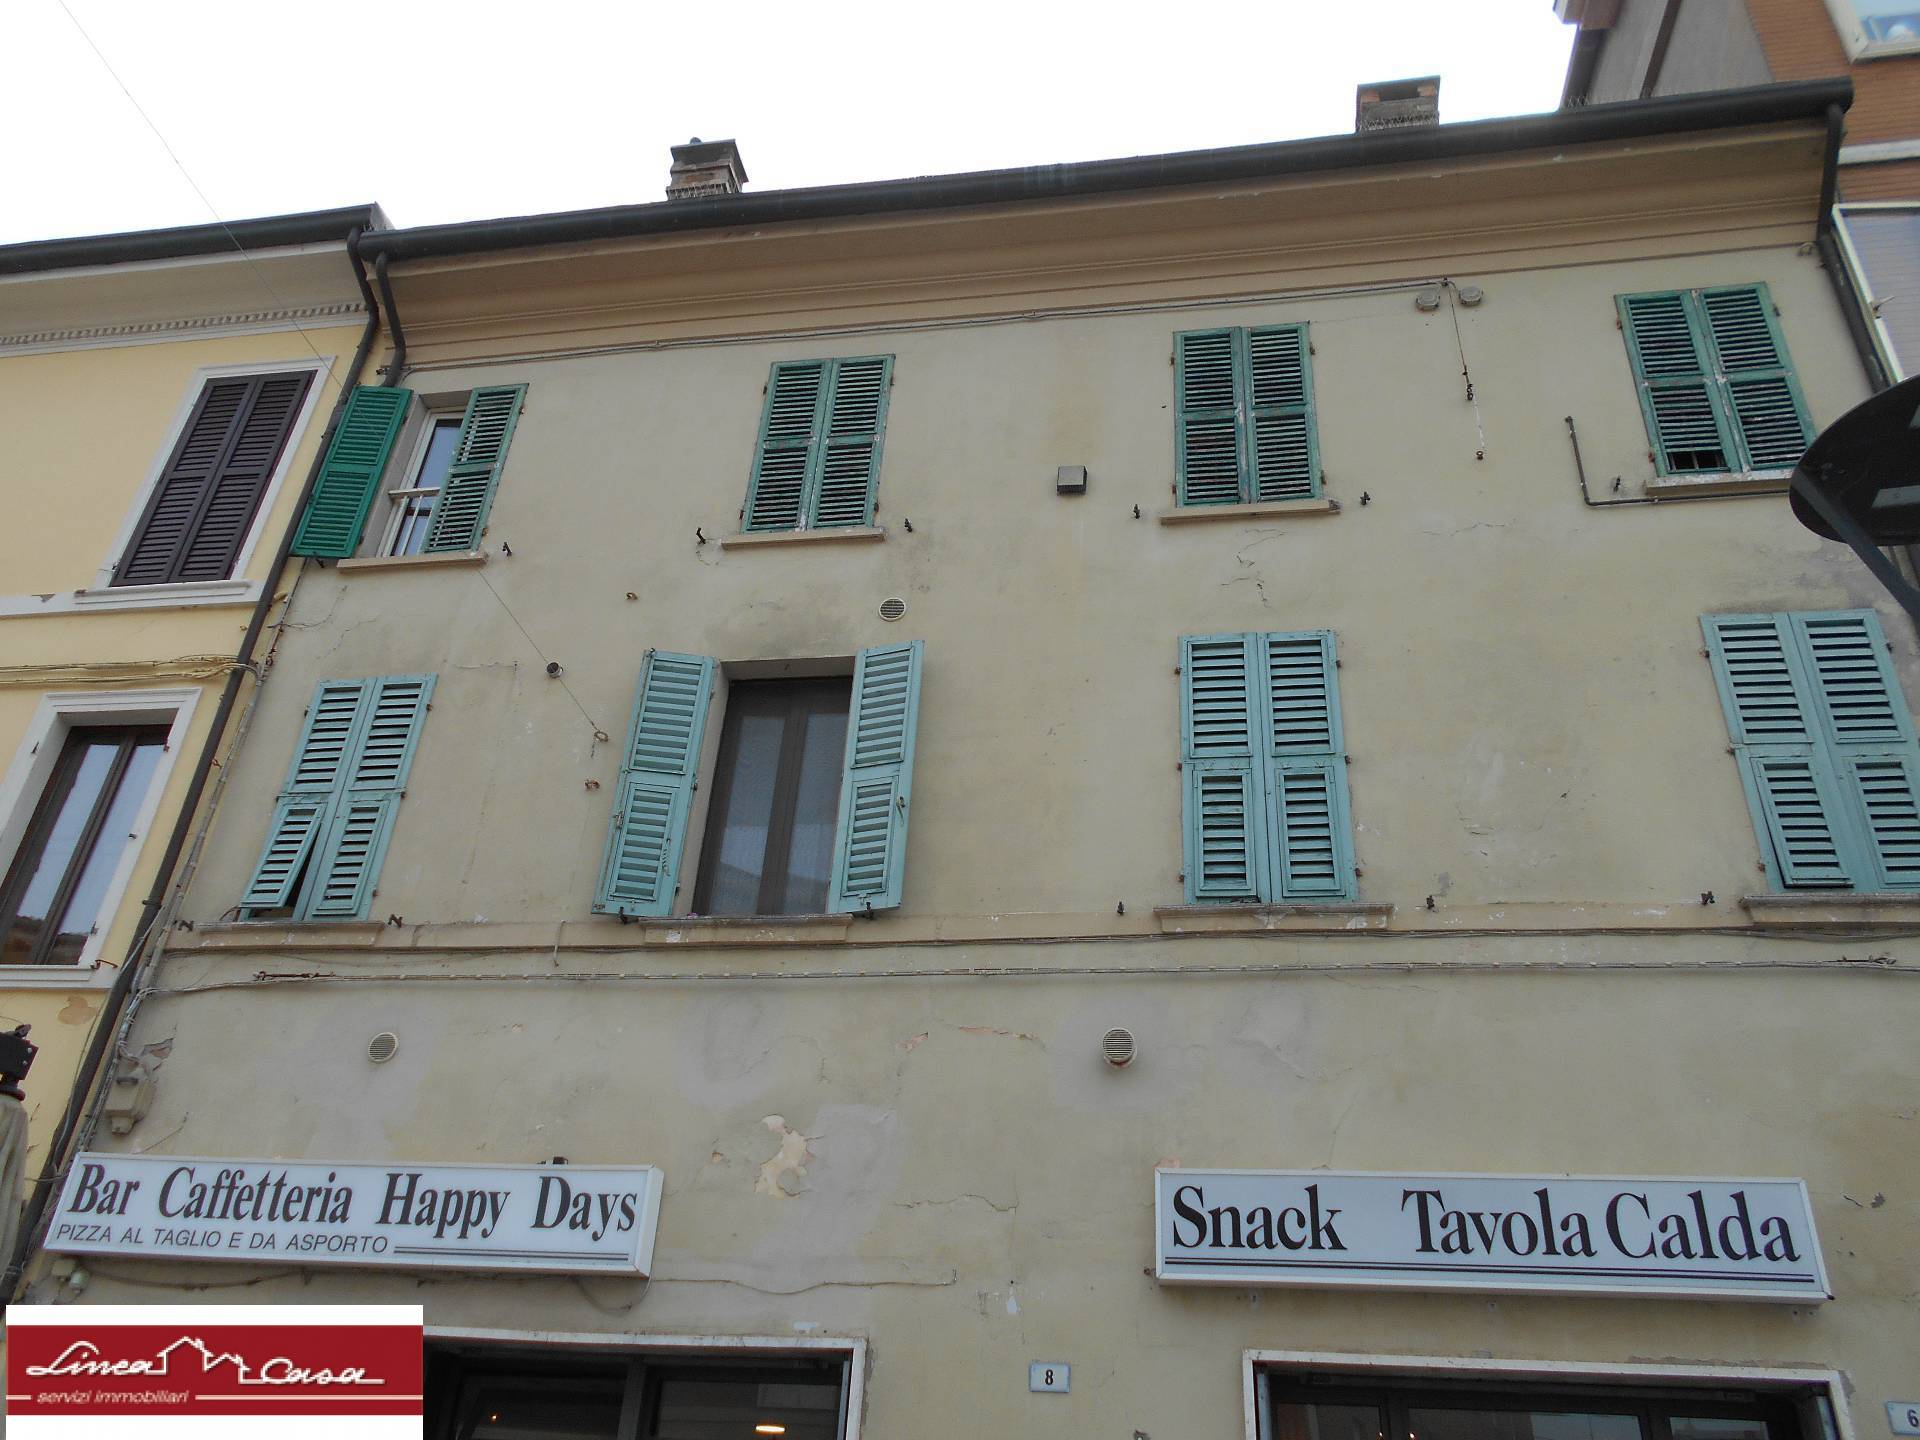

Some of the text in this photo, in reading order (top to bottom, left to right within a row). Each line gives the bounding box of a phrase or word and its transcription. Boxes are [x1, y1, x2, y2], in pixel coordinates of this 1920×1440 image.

[66, 1163, 638, 1242] Bar Caffetteria Happy Days
[1172, 1184, 1802, 1263] Snack Tavola Calda
[56, 1224, 389, 1255] PIZZA AL TAGLIO E DA ASPORTO
[1045, 1369, 1054, 1386] 8
